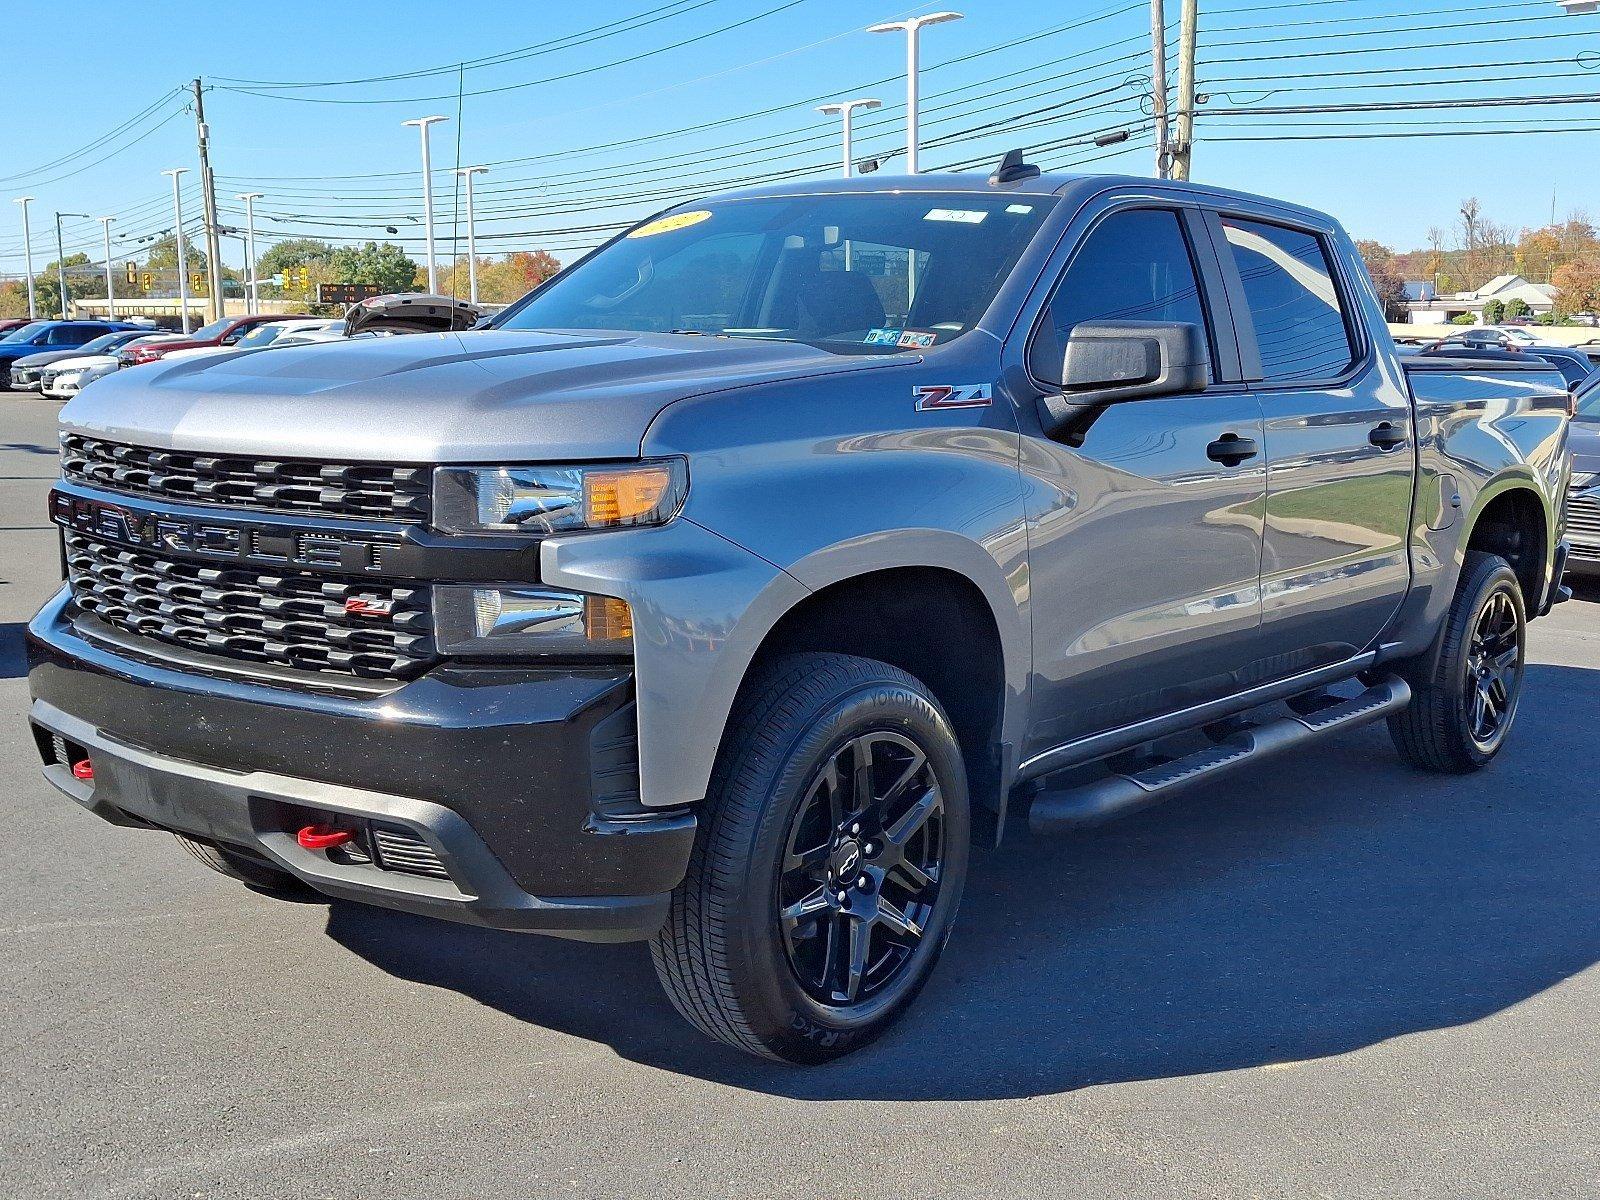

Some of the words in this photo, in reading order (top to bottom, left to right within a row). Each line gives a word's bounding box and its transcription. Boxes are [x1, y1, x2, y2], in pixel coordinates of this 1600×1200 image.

[912, 383, 992, 411] Z71
[50, 490, 403, 571] CHEVROLET
[871, 691, 937, 727] YOKOHAMA
